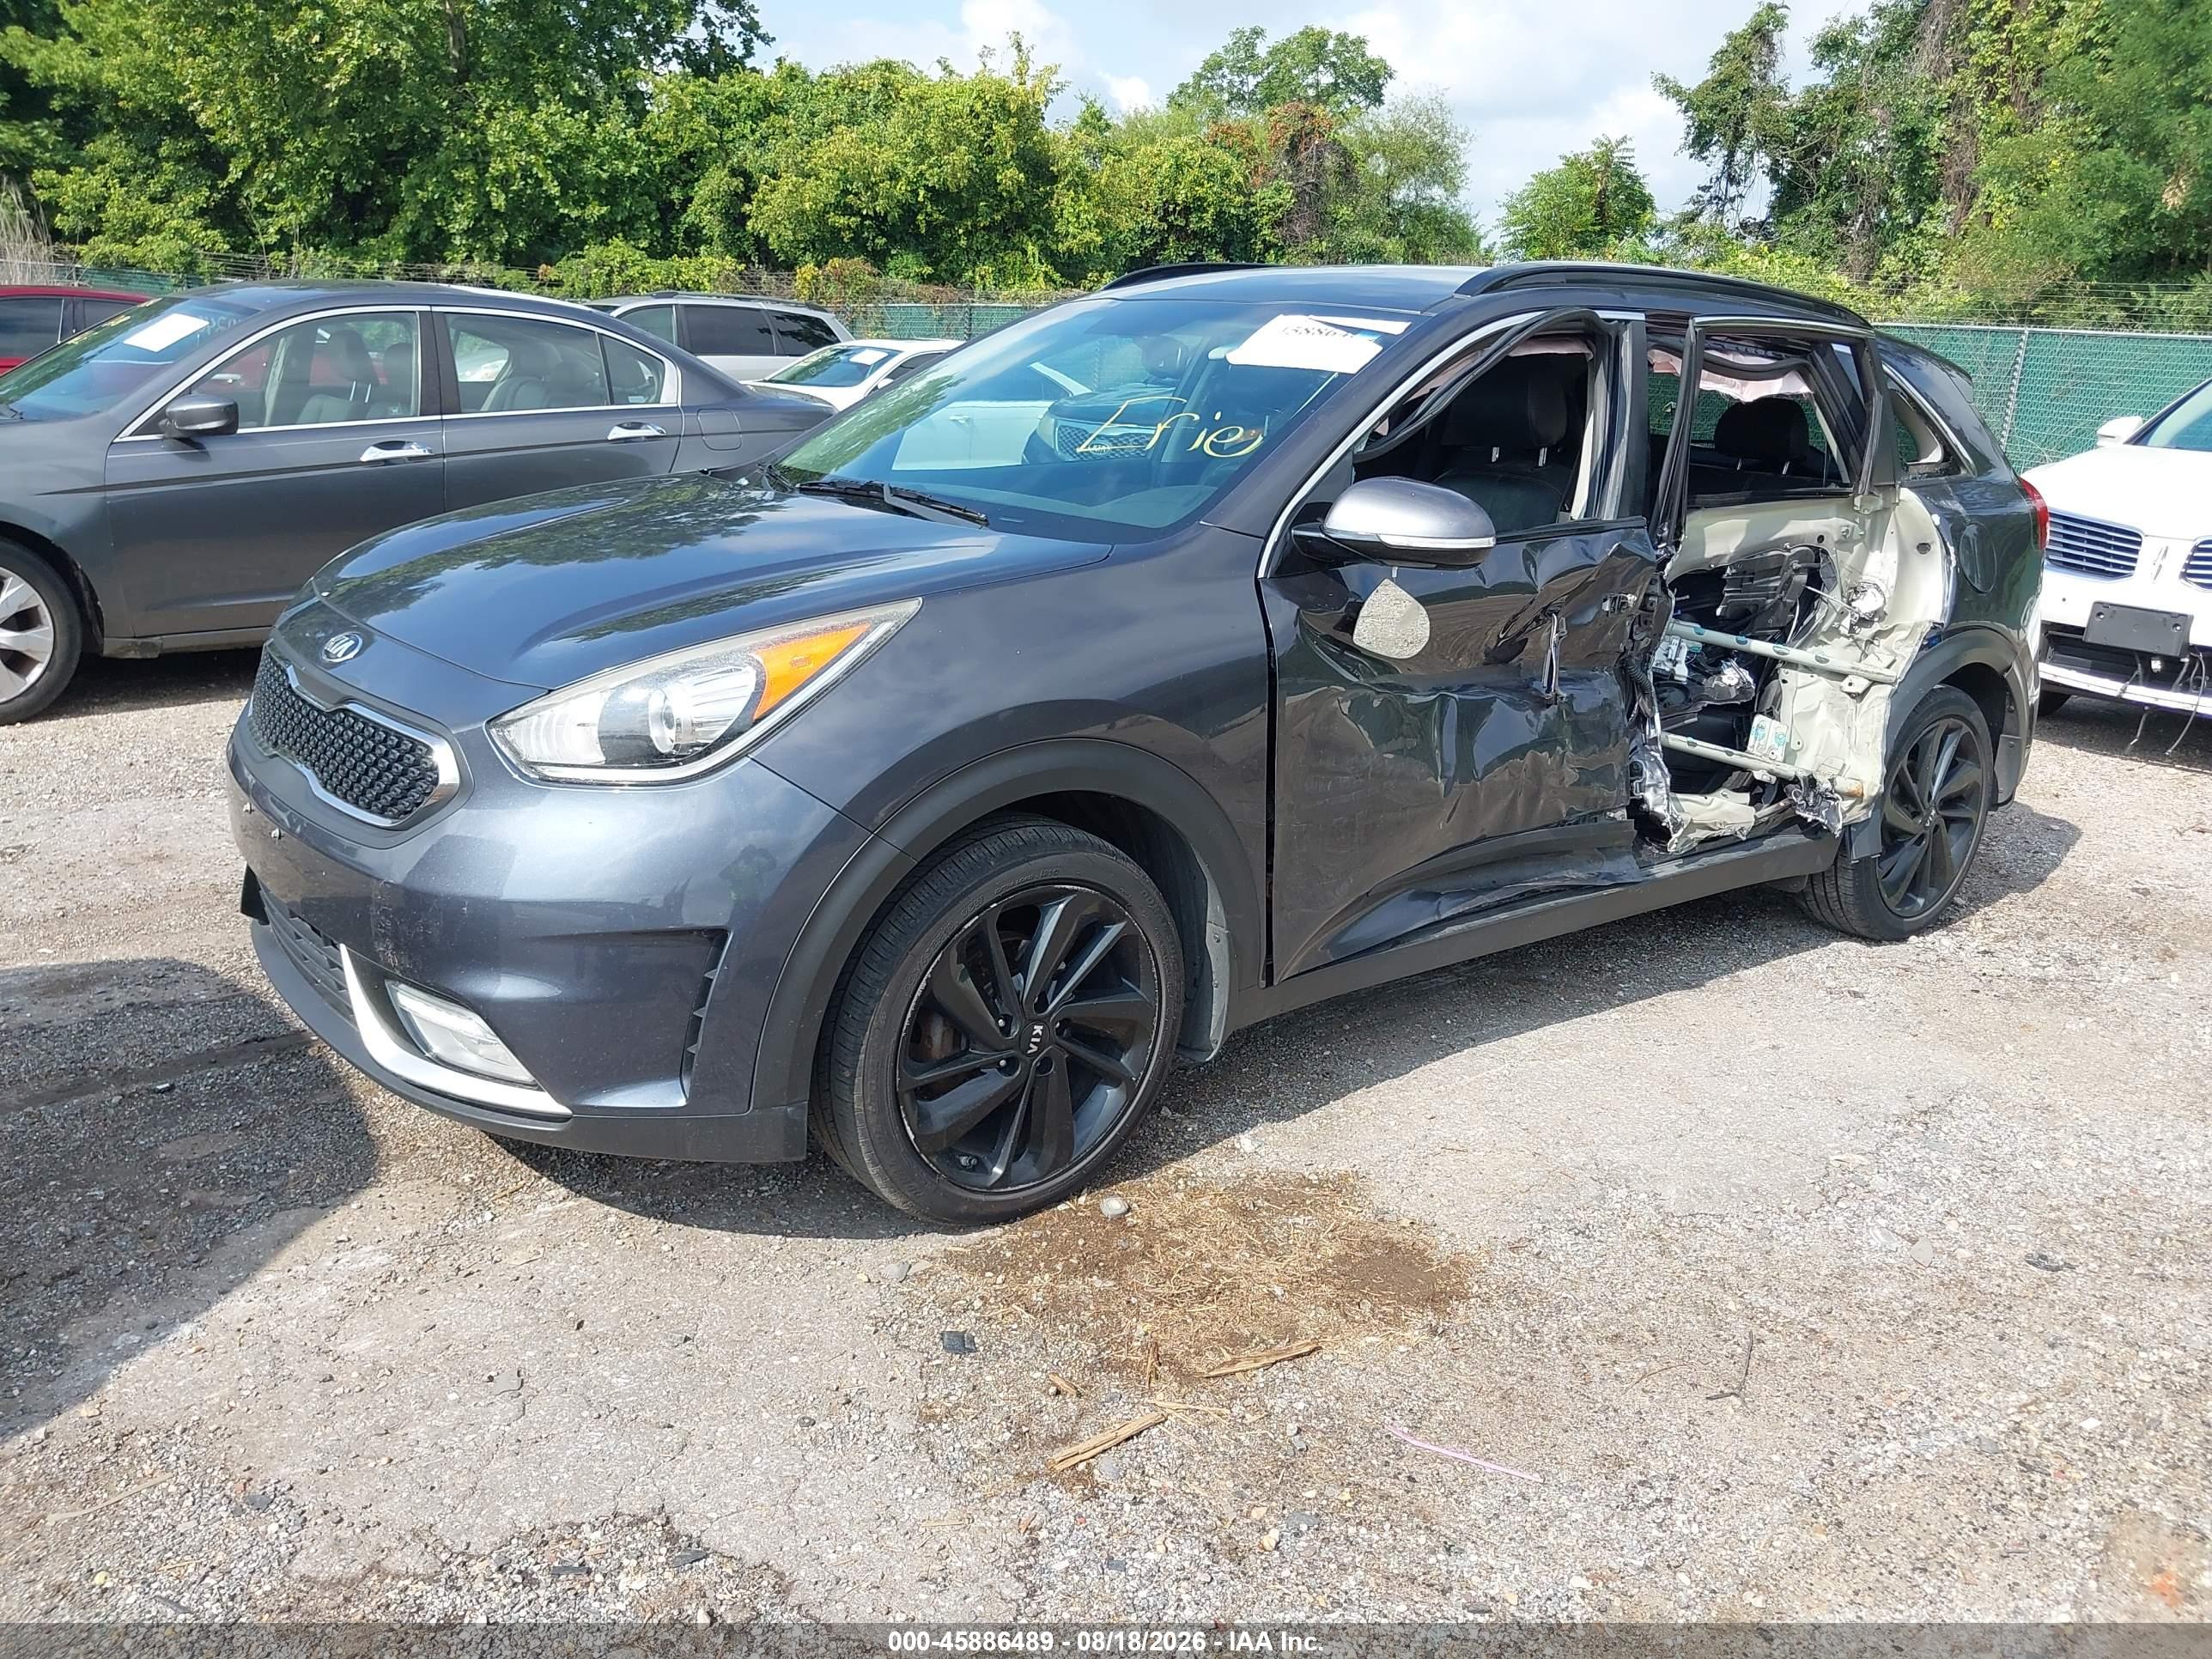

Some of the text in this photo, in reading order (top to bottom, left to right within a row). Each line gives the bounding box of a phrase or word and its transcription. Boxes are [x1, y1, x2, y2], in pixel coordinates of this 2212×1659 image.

[1076, 396, 1265, 458] Erie
[324, 634, 357, 659] KIA
[1026, 1024, 1044, 1054] KIA
